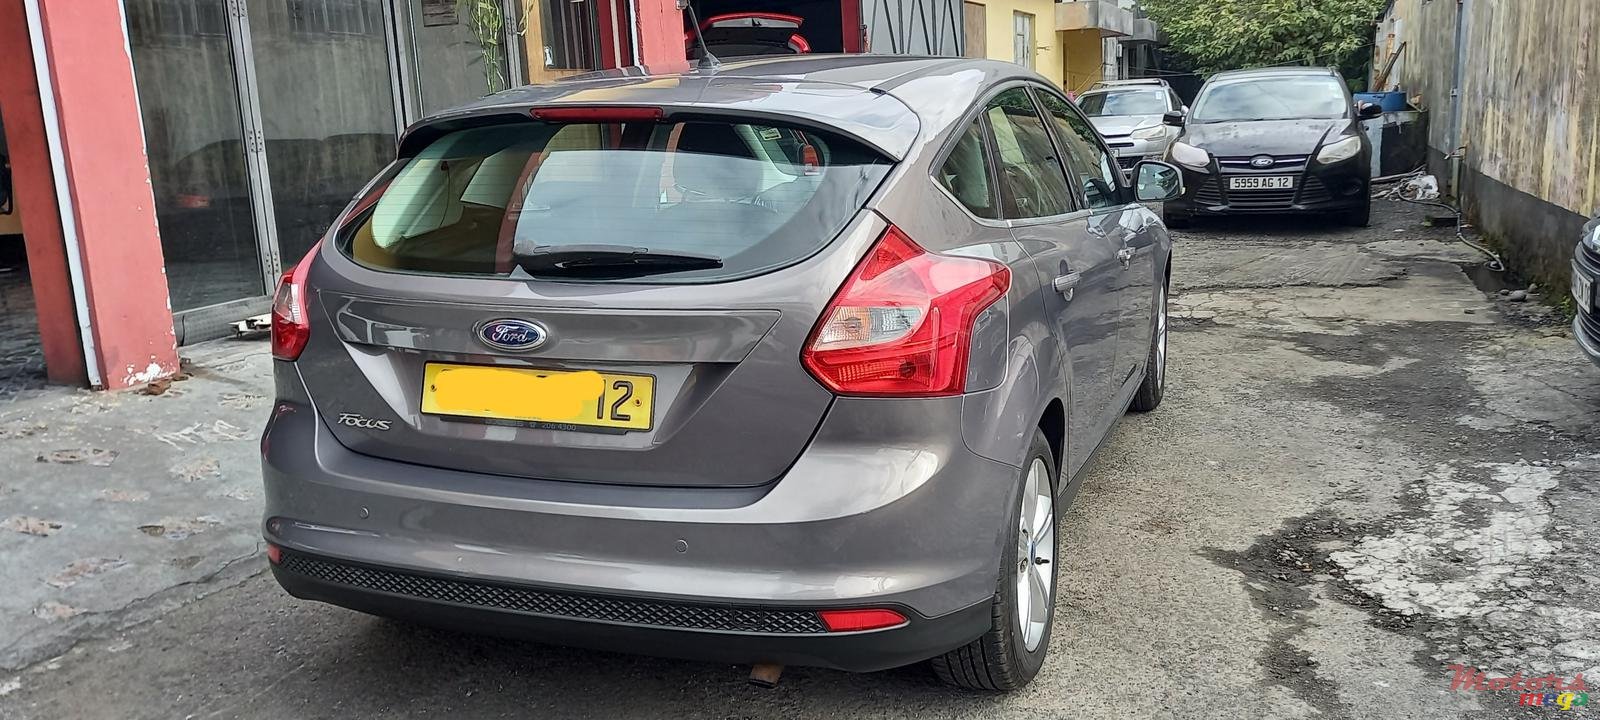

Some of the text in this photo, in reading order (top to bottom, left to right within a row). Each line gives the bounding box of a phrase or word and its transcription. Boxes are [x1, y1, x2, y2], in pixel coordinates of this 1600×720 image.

[1234, 177, 1289, 188] 5959 AG 12
[491, 324, 529, 342] Ford
[596, 379, 634, 422] 12
